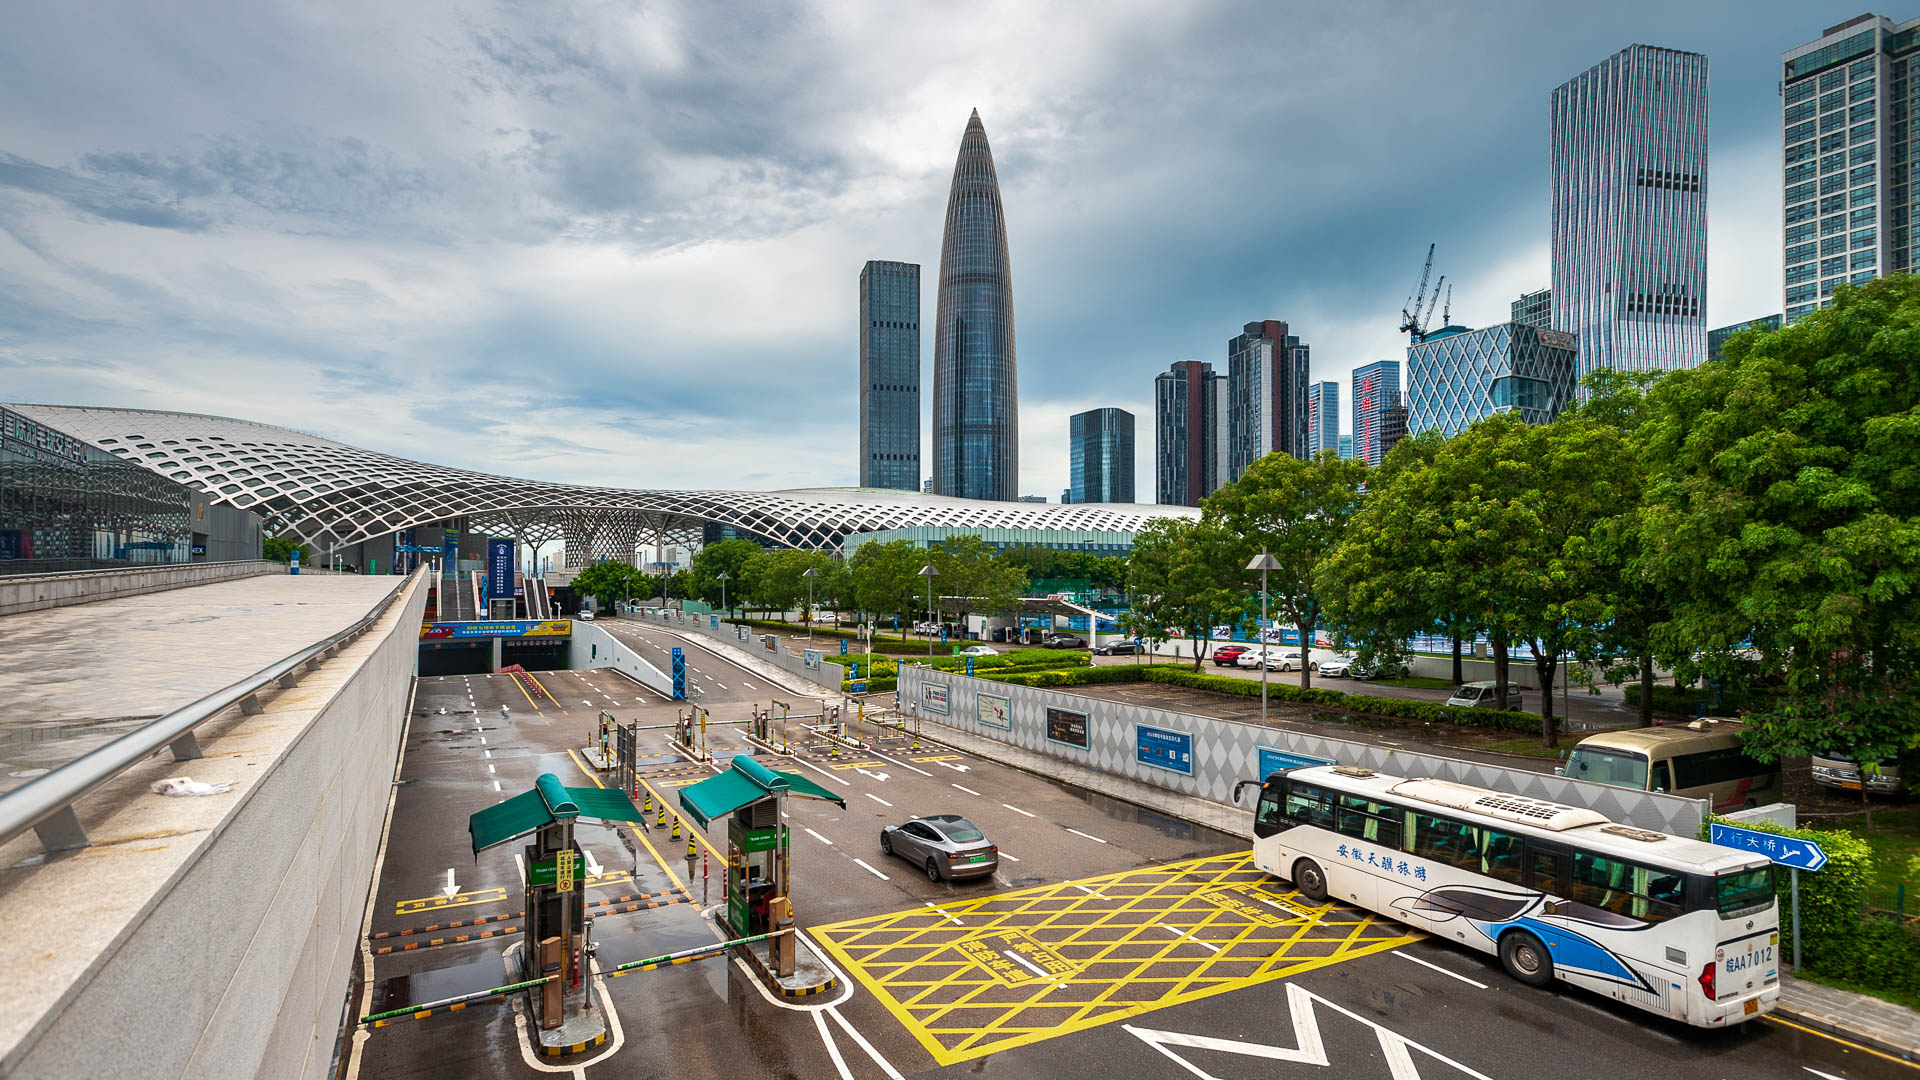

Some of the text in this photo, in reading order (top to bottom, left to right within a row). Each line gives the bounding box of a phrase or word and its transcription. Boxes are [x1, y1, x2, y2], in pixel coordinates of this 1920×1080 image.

[1716, 830, 1776, 851] 人行天桥
[962, 941, 1033, 983] 消防车道
[1726, 947, 1772, 973] 皖AA7012
